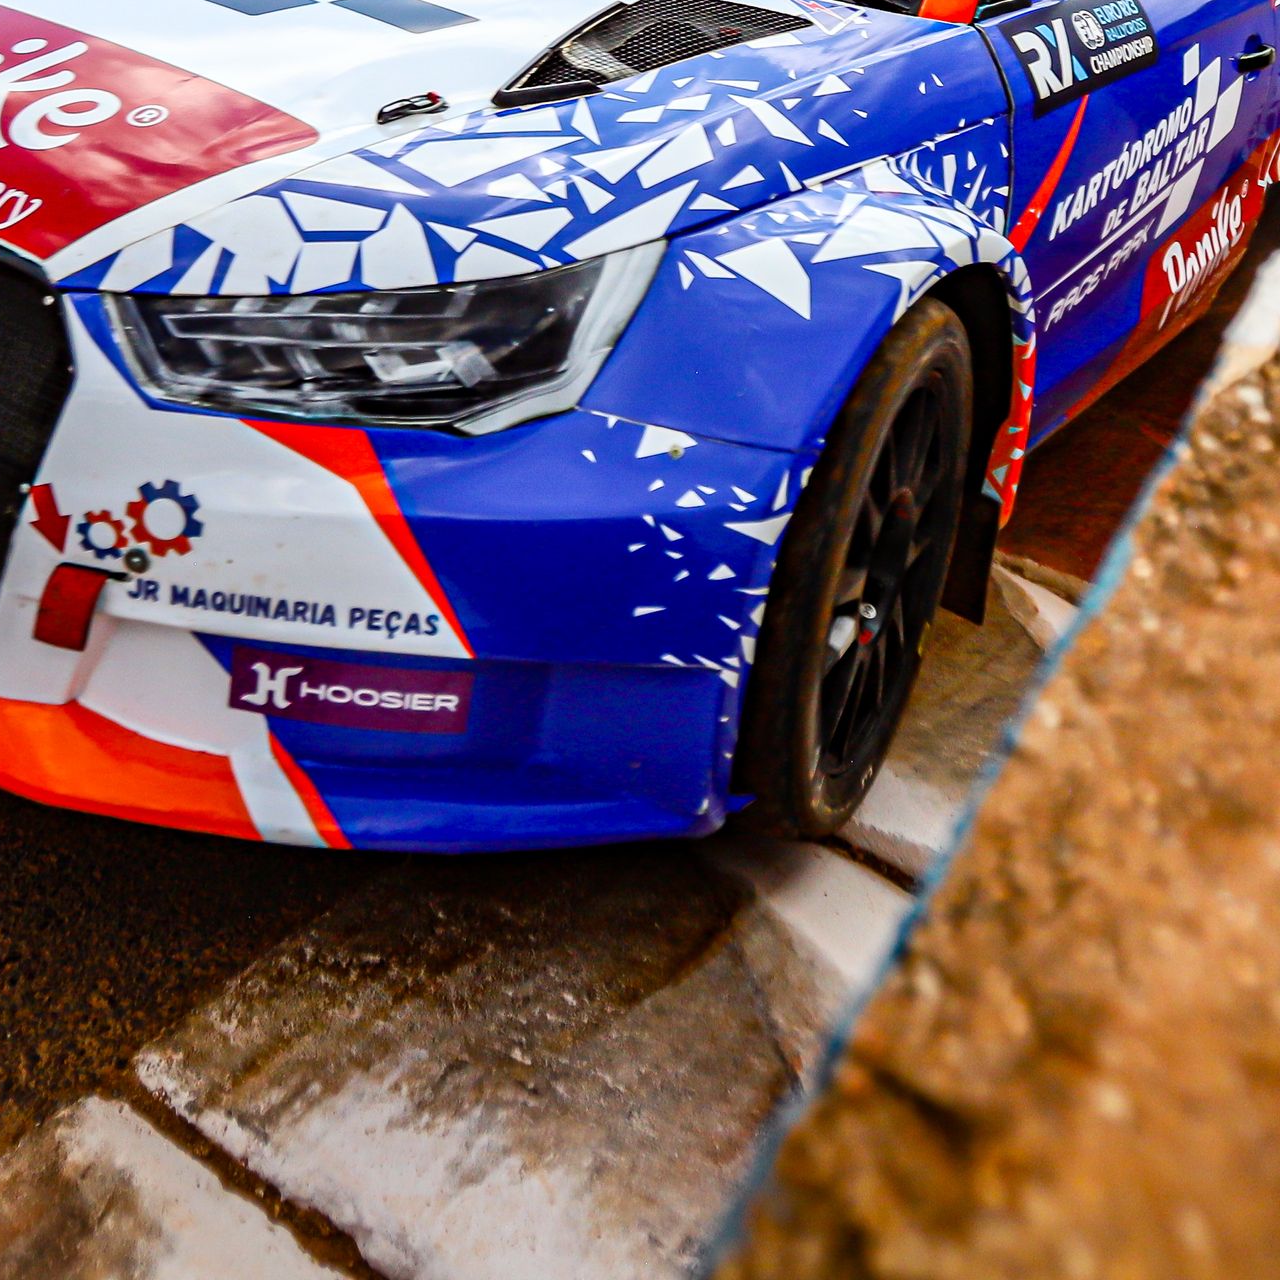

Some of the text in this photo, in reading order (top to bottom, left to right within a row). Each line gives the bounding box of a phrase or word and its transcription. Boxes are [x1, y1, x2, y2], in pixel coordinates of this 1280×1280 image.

[1093, 2, 1123, 25] EURO
[1104, 17, 1147, 43] RALLYCROSS
[1011, 17, 1089, 101] RX
[1090, 35, 1155, 75] CHAMPIONSHIP
[1048, 96, 1193, 242] KARTÓDROMO
[1100, 116, 1210, 240] DE BALTAR
[126, 577, 441, 639] JR MAQUINARIA PEÇAS
[298, 680, 460, 713] HOOSIER
